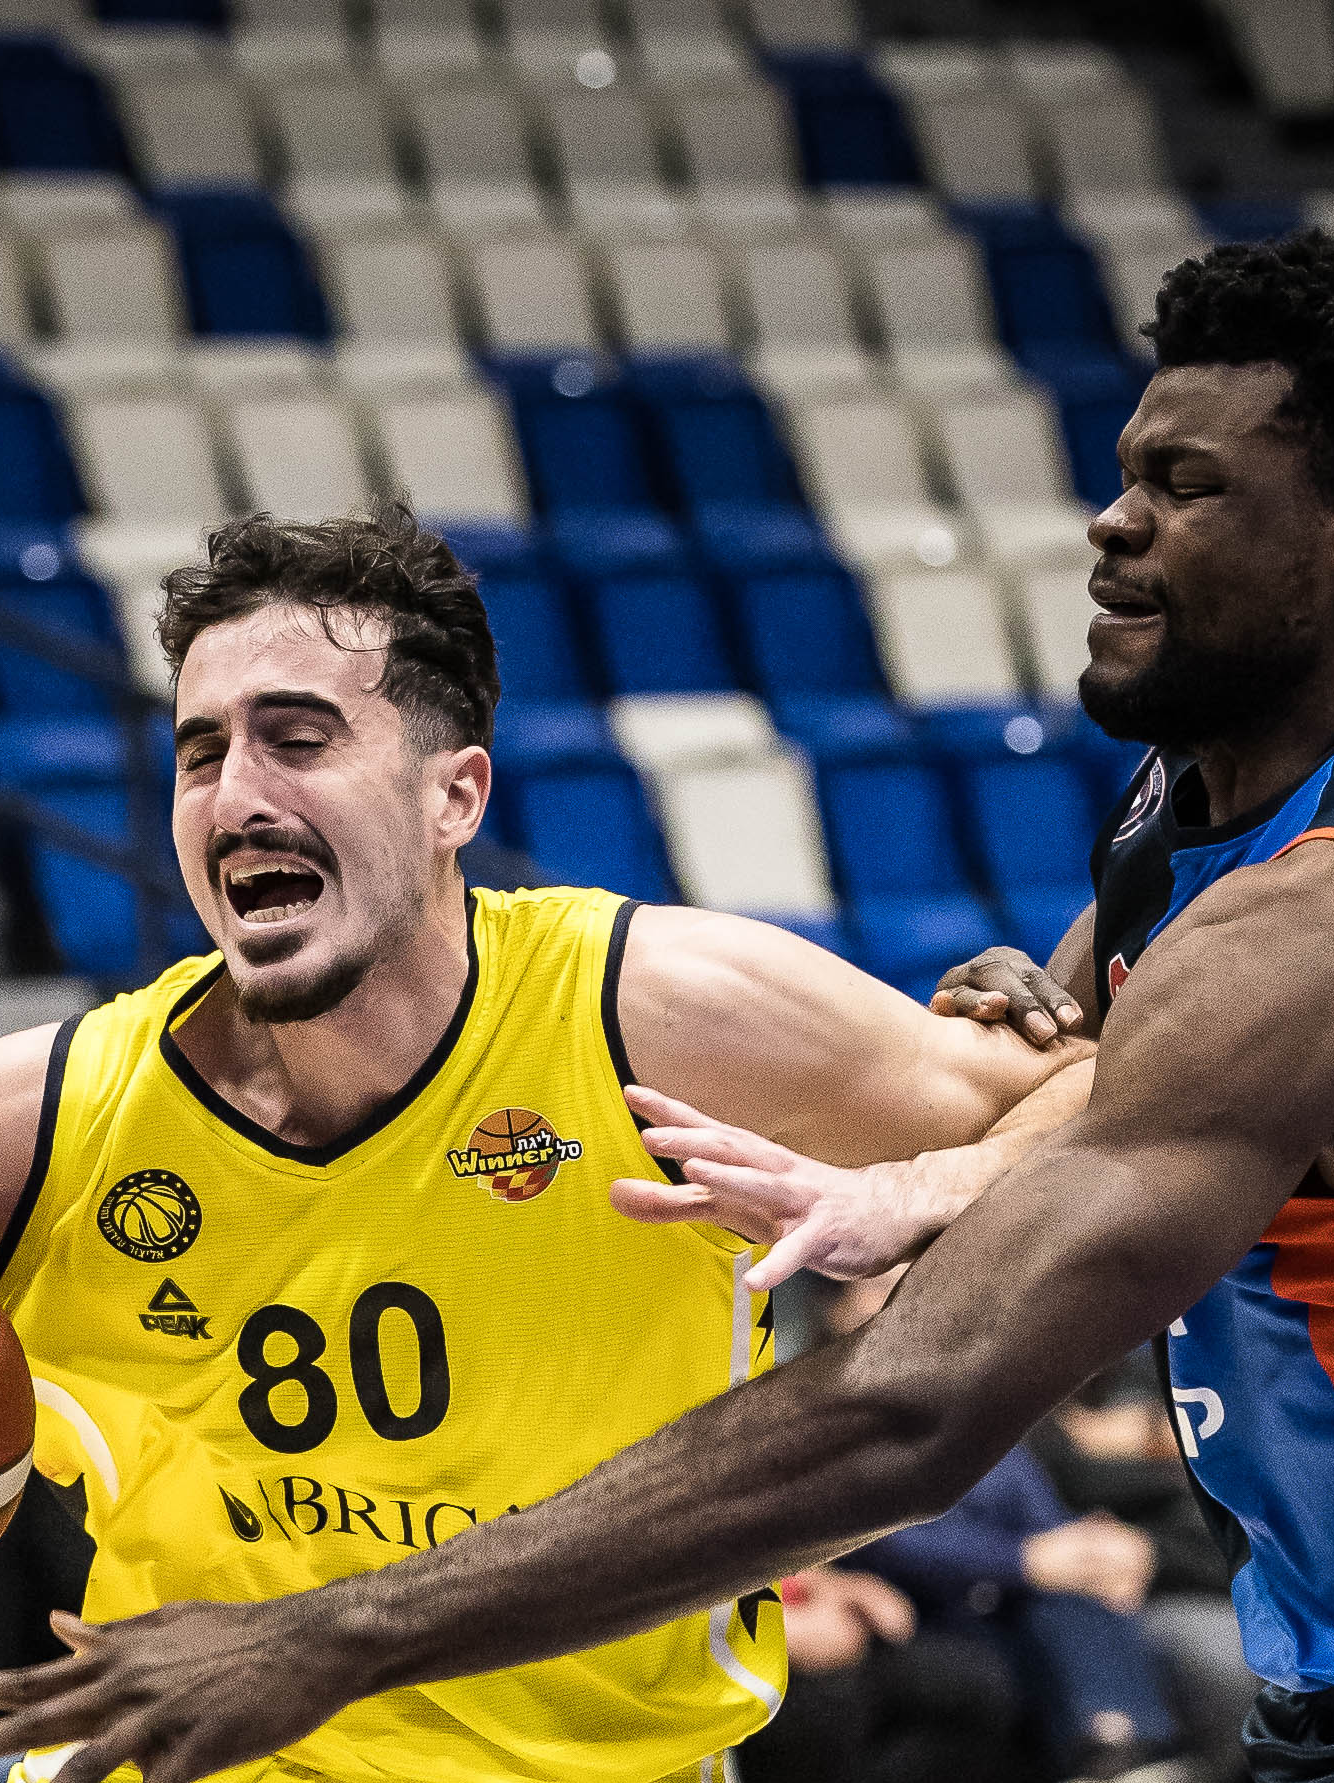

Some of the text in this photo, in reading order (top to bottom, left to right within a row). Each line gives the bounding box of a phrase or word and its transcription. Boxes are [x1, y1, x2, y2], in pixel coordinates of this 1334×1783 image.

[517, 1130, 552, 1152] ליגת
[556, 1140, 580, 1160] סל
[449, 1147, 555, 1175] Winner
[138, 1313, 215, 1341] PEAK
[237, 1281, 452, 1455] 80
